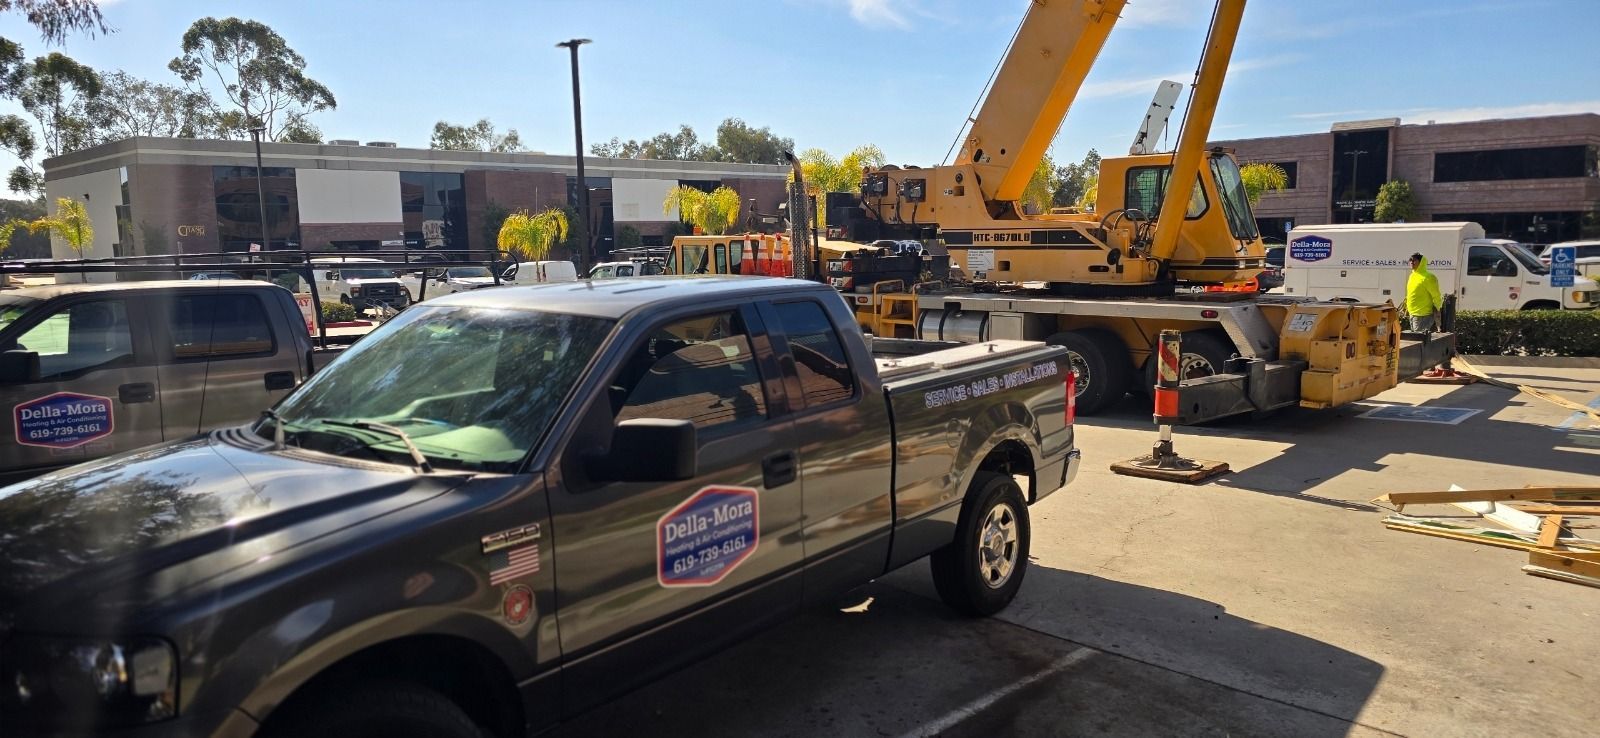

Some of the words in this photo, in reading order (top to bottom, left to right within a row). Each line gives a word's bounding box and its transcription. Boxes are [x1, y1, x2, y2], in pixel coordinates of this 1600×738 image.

[925, 384, 967, 408] SERVICE
[971, 376, 999, 397] SALES
[1003, 361, 1057, 389] INSTALLATIONS
[21, 403, 106, 420] Della-Mora
[67, 415, 106, 424] Conditioning
[30, 423, 101, 438] 619-739-6161
[665, 501, 752, 543] Della-Mora
[666, 541, 694, 557] Heating
[702, 534, 711, 543] Air
[712, 520, 752, 539] Conditioning
[673, 535, 747, 574] 619-739-6161
